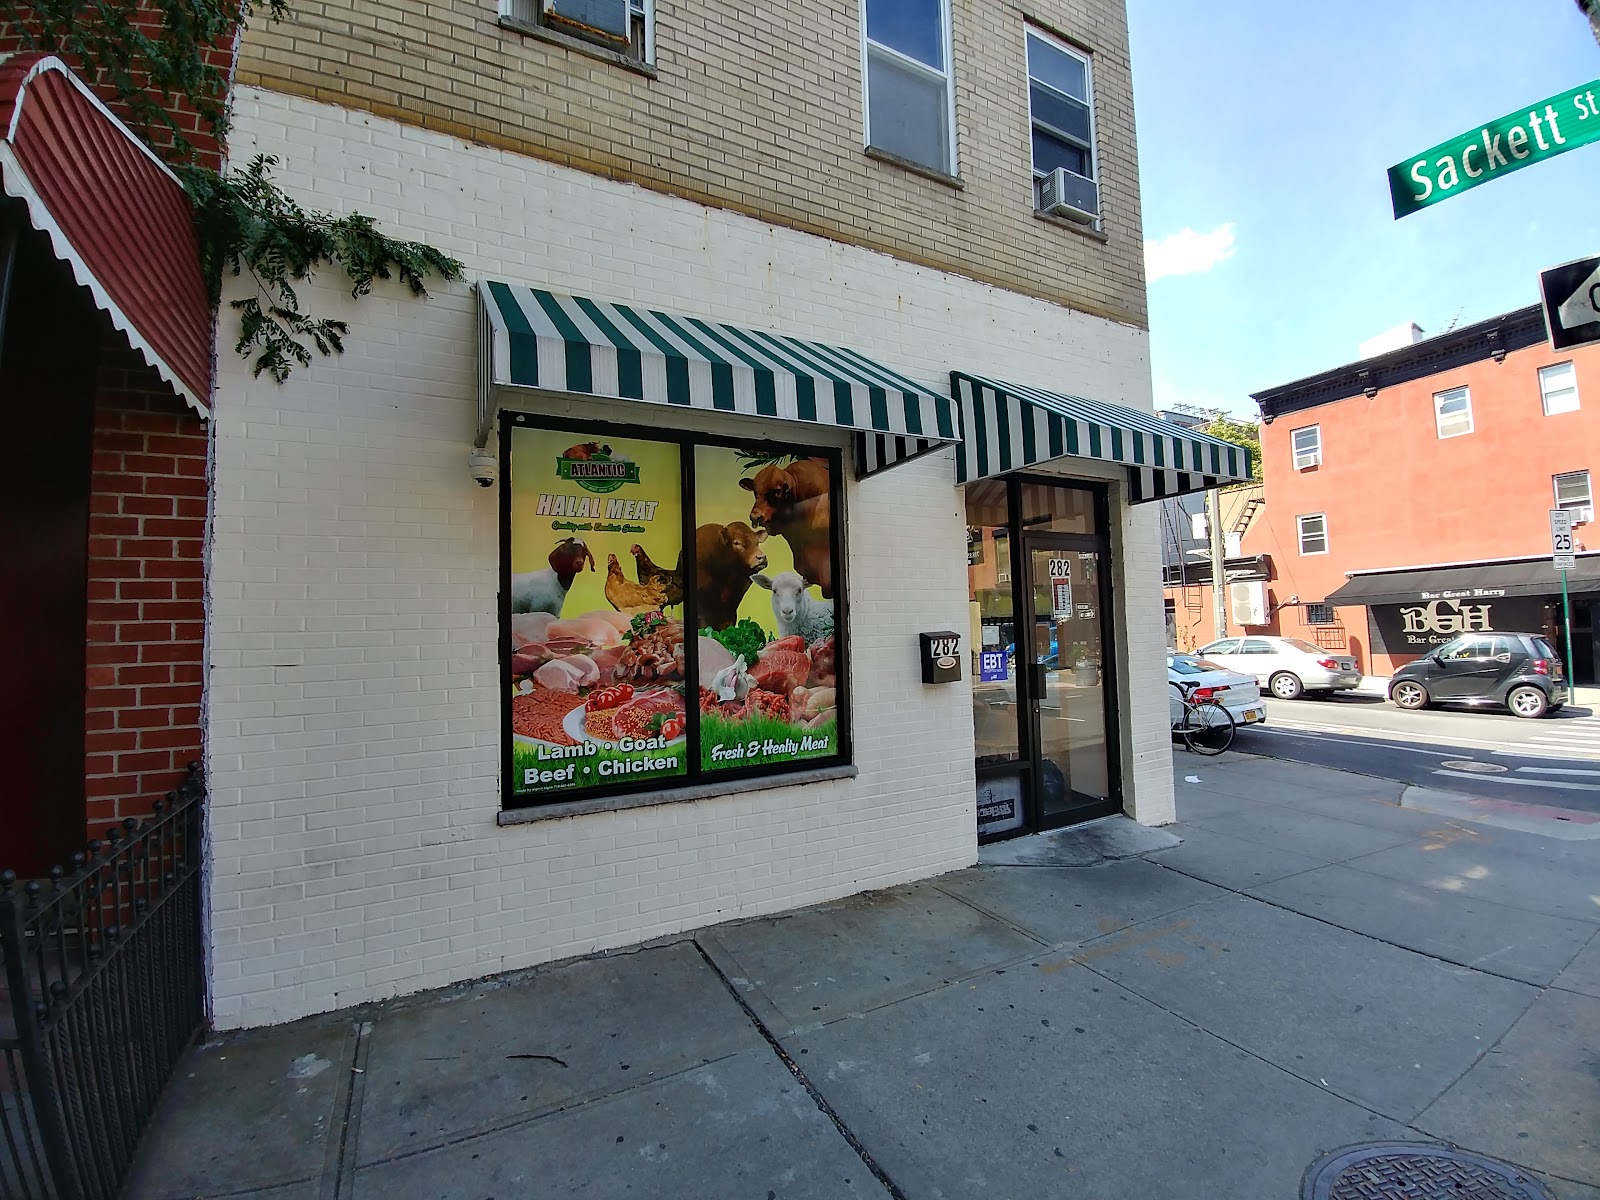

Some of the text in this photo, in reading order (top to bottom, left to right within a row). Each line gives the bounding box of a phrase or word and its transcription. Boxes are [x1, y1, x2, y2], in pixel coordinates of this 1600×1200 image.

[1410, 90, 1600, 201] Sackett St
[570, 462, 626, 478] ATLANTIC
[536, 494, 659, 521] HALAL MEAT
[1554, 534, 1571, 550] 25
[1049, 559, 1070, 577] 282
[1421, 588, 1505, 600] Bar Great Harry
[1399, 599, 1494, 634] BGH
[932, 638, 960, 657] 282
[1407, 634, 1426, 644] Bar
[983, 653, 1003, 669] EBT
[538, 734, 666, 761] Lamb Goat
[711, 735, 829, 761] Fresh & Healty Meat
[524, 756, 678, 785] Beef Chicken
